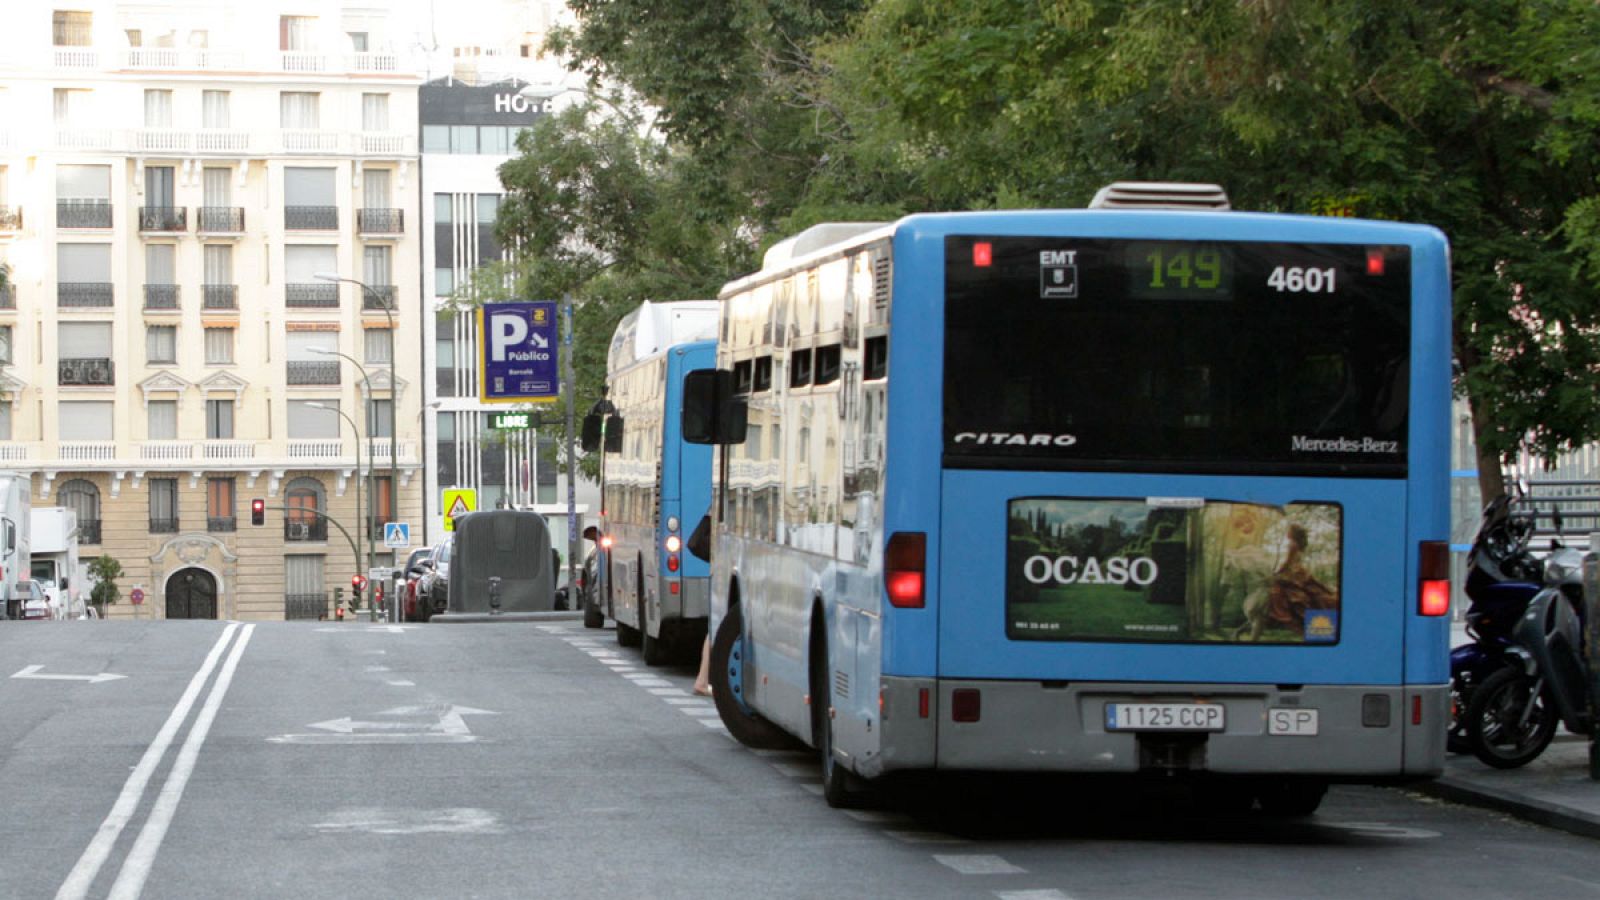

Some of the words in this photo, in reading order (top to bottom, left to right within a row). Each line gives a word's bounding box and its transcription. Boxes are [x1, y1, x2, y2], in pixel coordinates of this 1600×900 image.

[1039, 250, 1077, 265] EMT
[1147, 250, 1221, 288] 149
[1267, 266, 1336, 293] 4601
[491, 314, 528, 361] P
[508, 351, 550, 361] Público
[495, 415, 529, 429] LIBRE
[954, 432, 1077, 446] CITARO
[1291, 435, 1398, 453] Mercedes-Benz
[1023, 555, 1158, 585] OCASO
[1124, 707, 1173, 726] 1125
[1179, 708, 1218, 727] CCP
